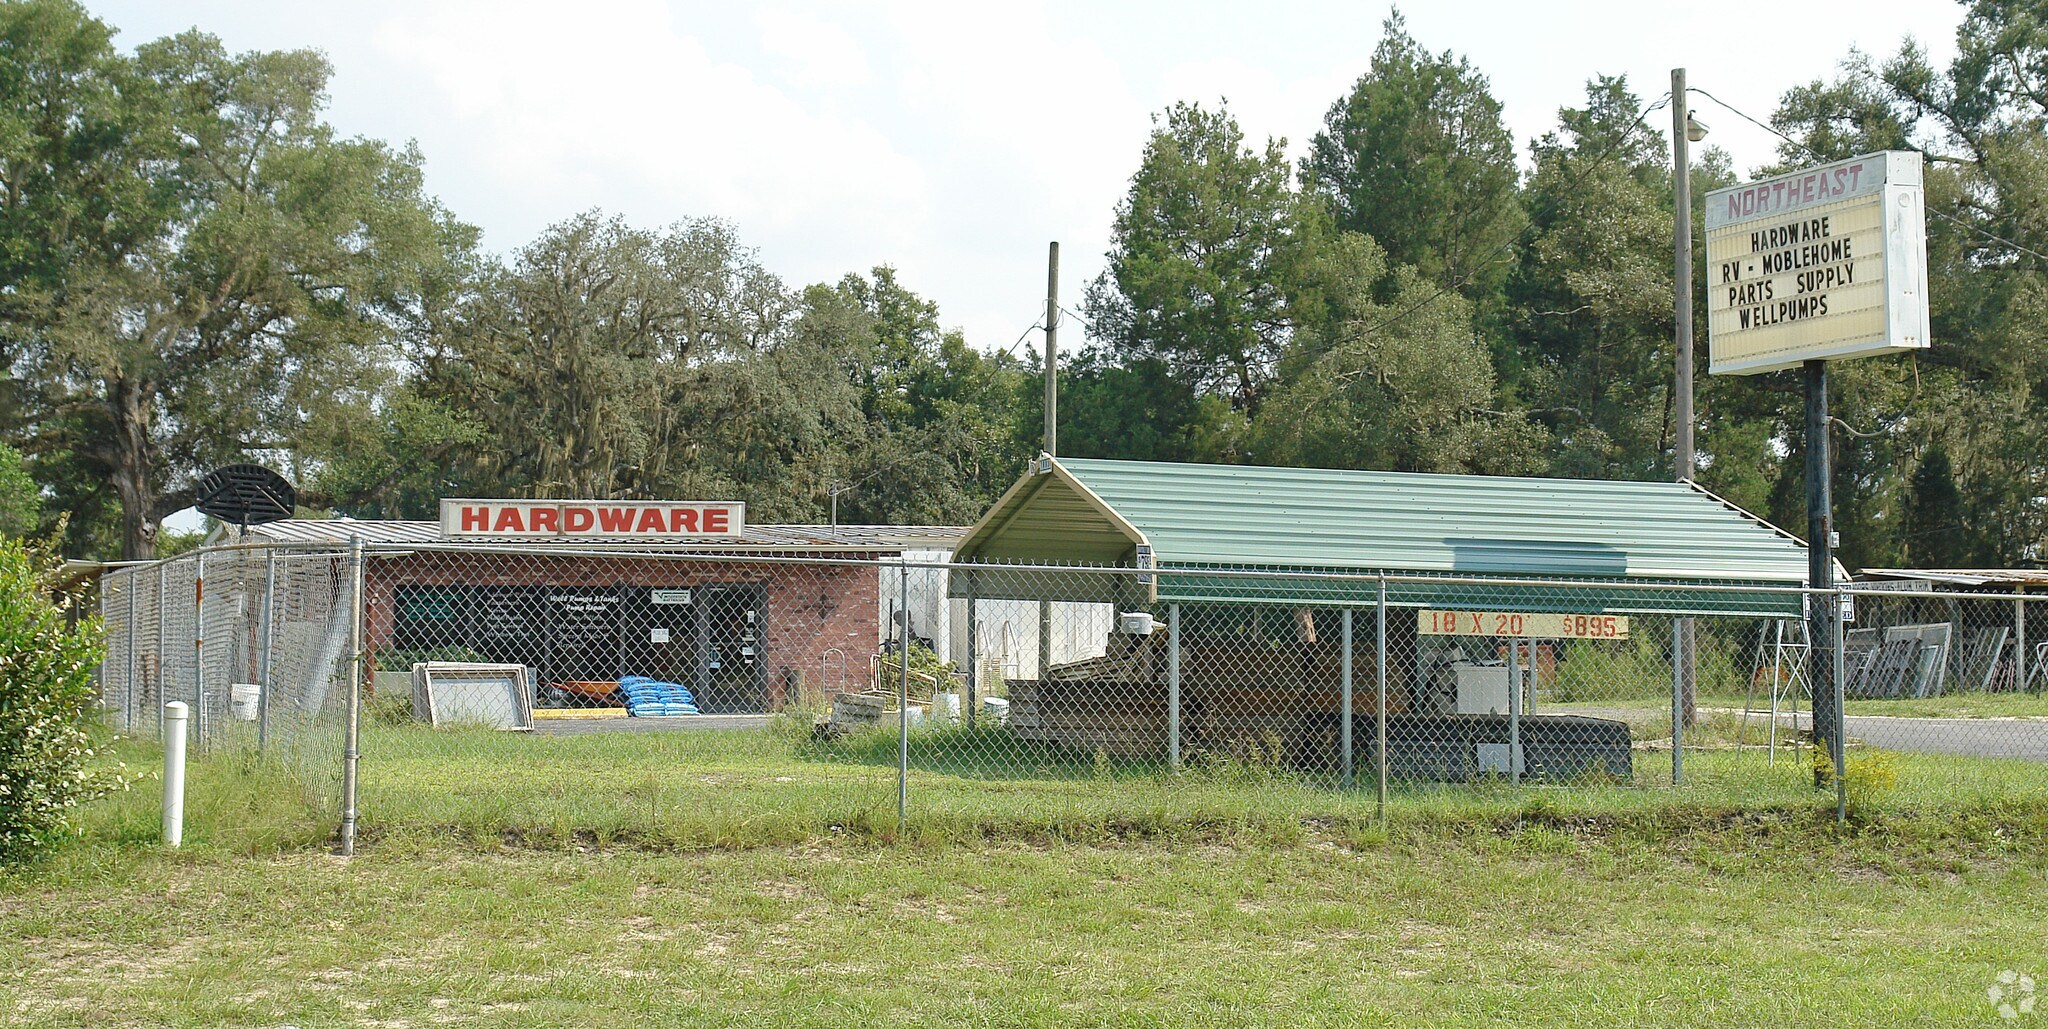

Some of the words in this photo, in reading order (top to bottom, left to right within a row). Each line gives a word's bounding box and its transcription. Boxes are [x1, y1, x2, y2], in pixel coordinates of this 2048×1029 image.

[1728, 164, 1863, 219] NORTHEAST
[1751, 217, 1830, 252] HARDWARE
[1722, 261, 1740, 283] RV
[1762, 238, 1851, 275] MOBLEHOME
[1729, 280, 1773, 306] PARTS
[1797, 263, 1854, 294] SUPPLY
[1739, 295, 1828, 329] WELLPUMPS
[461, 507, 729, 533] HARDWARE
[566, 604, 584, 612] Pump
[1472, 613, 1483, 633] X
[1563, 615, 1616, 637] $895
